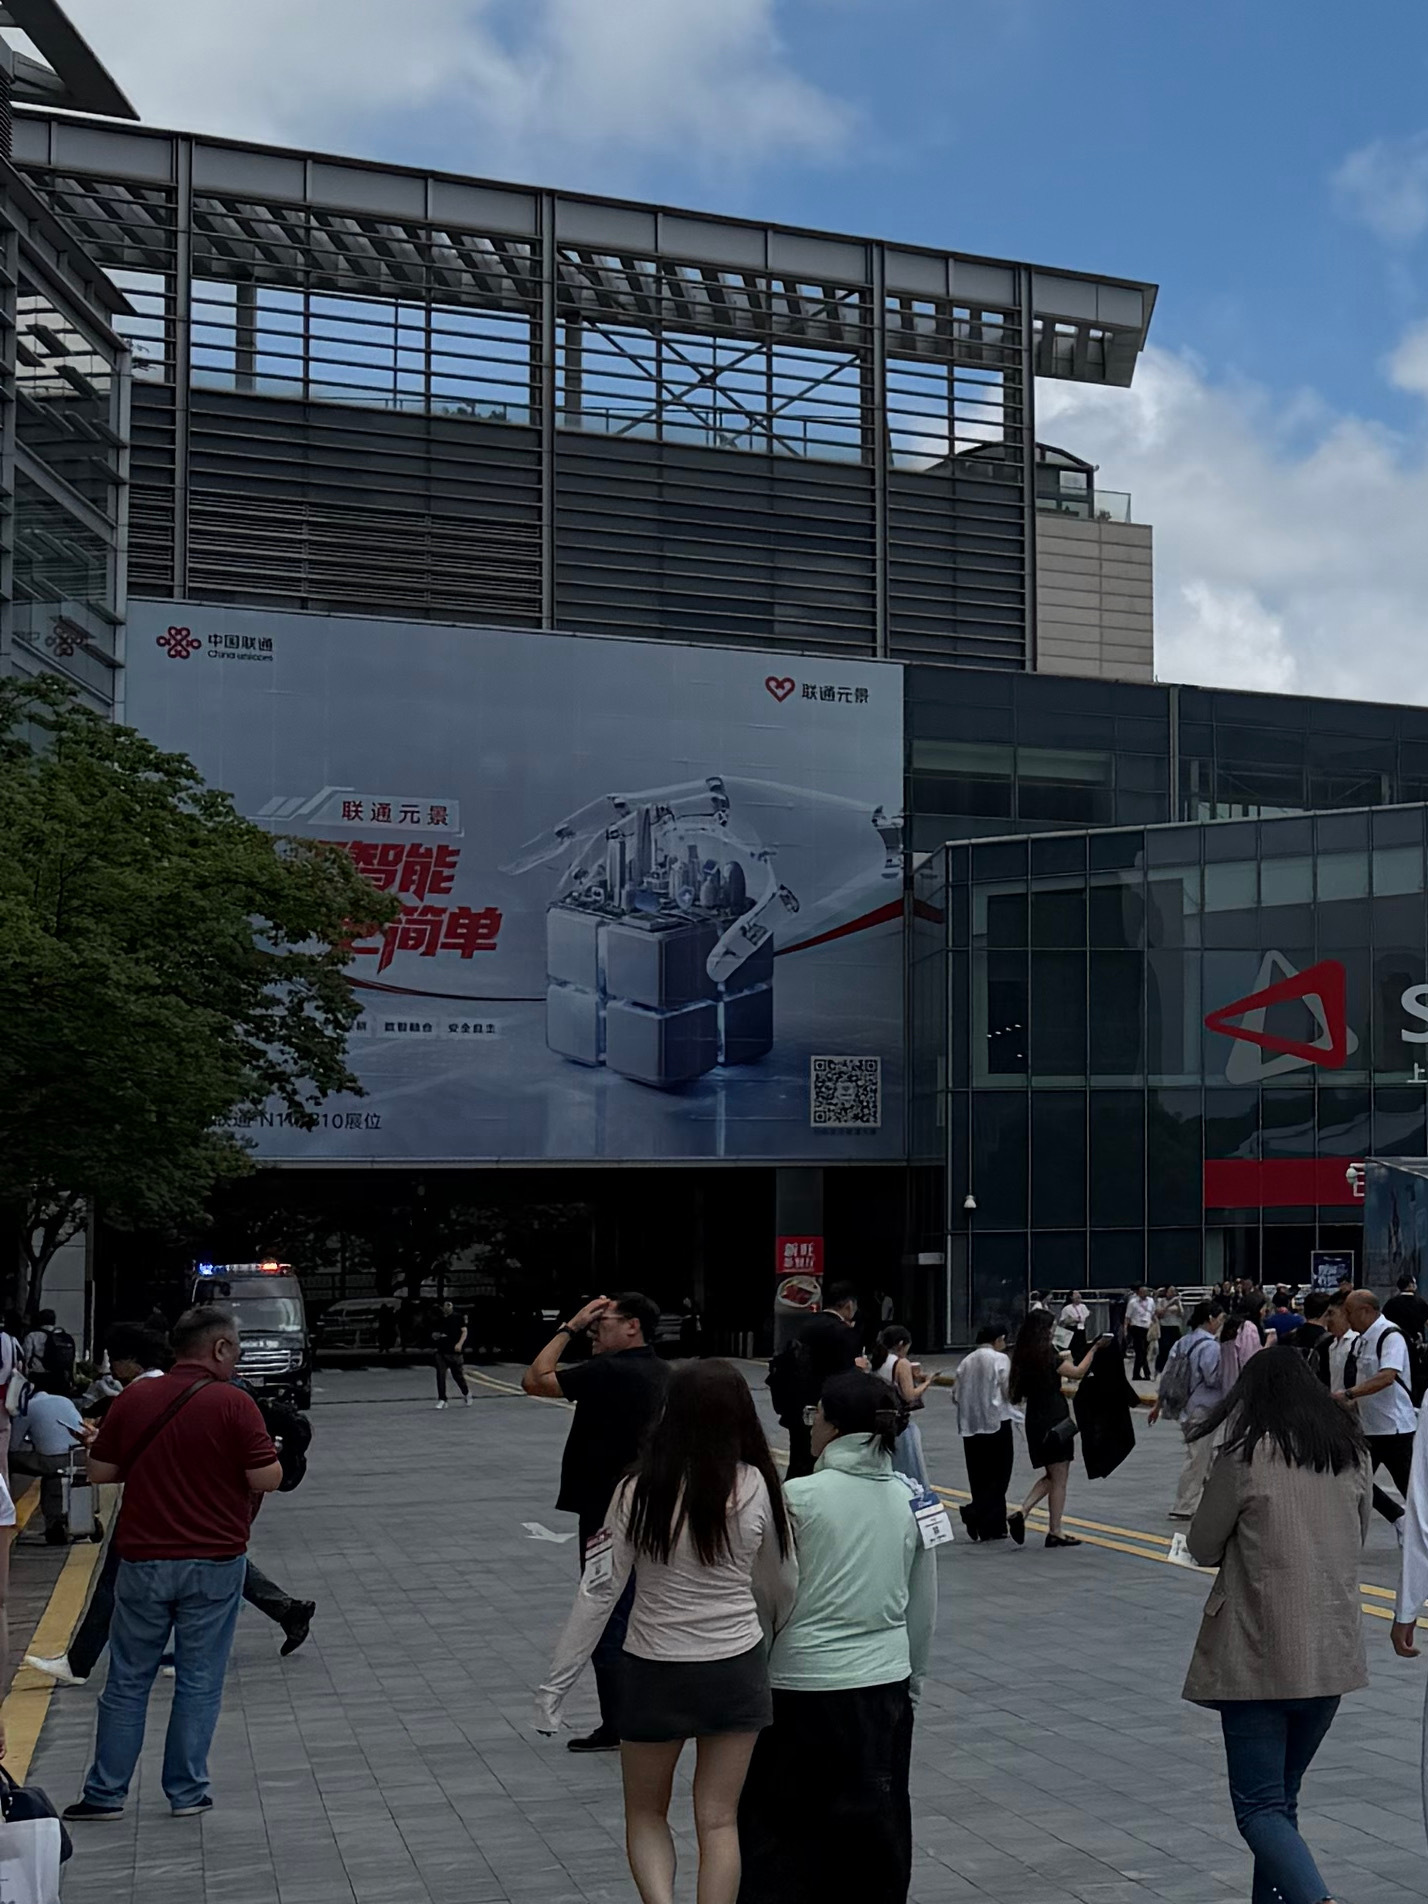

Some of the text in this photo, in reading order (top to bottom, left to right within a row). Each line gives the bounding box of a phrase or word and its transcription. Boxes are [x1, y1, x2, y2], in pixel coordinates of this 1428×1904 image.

[208, 634, 273, 652] 中国联通
[801, 683, 869, 704] 联通元景
[341, 800, 449, 826] 联通元景
[319, 840, 461, 902] 智能
